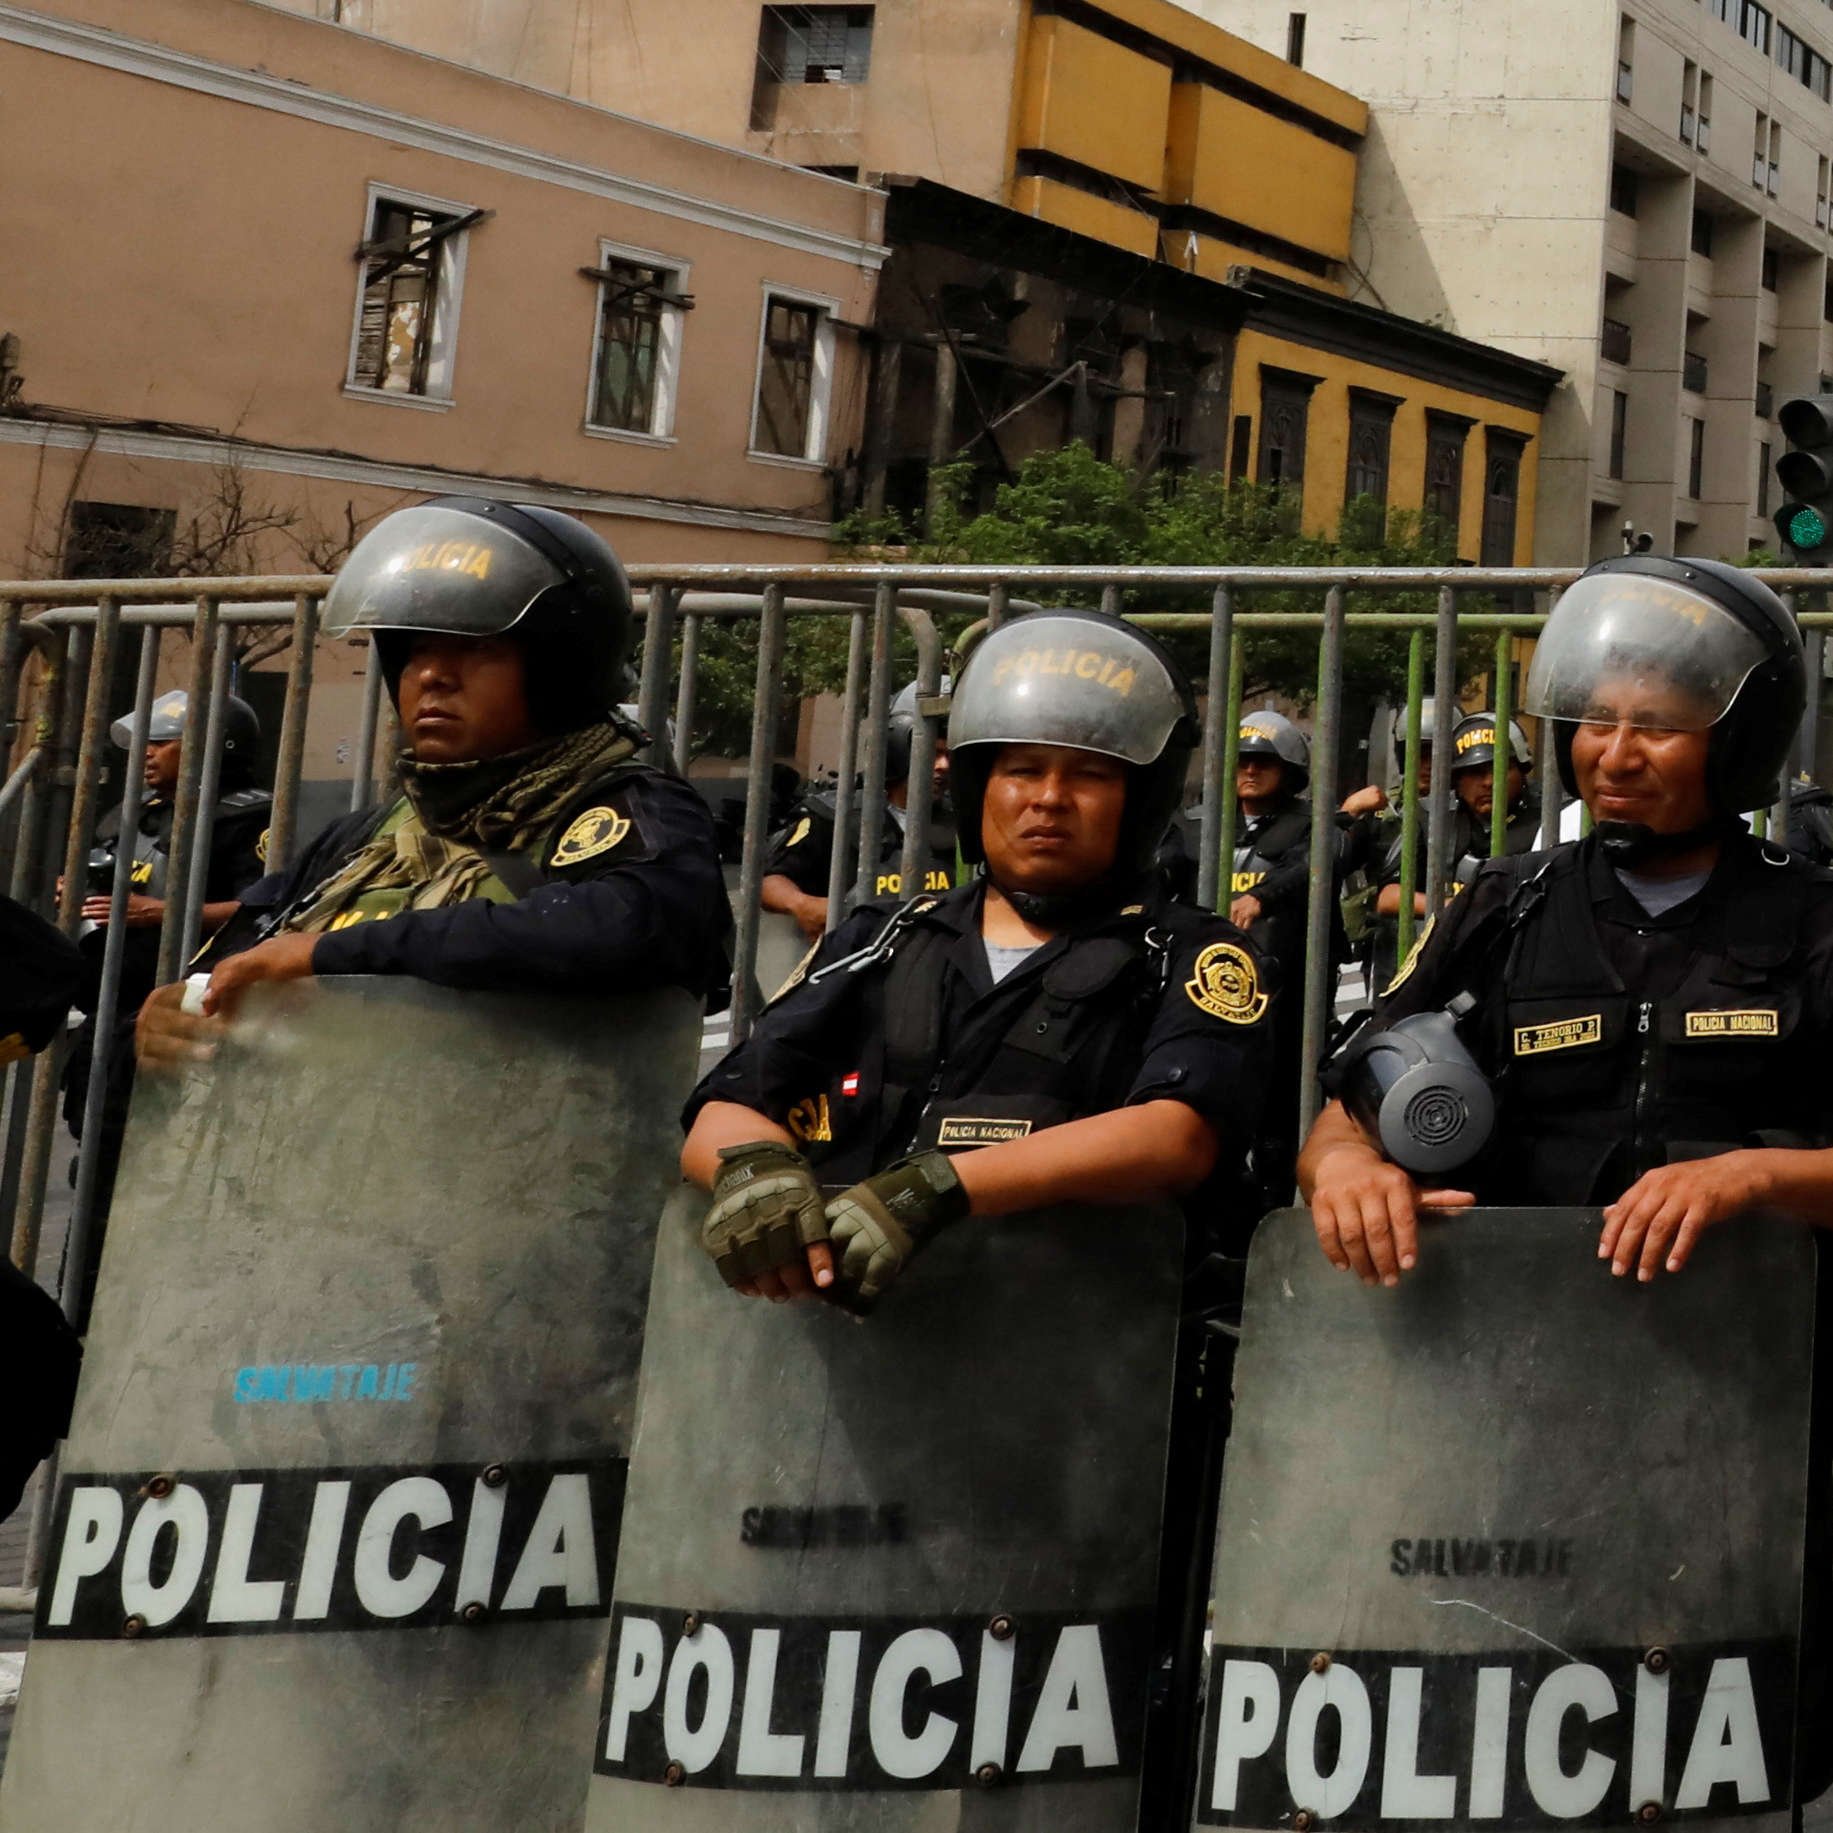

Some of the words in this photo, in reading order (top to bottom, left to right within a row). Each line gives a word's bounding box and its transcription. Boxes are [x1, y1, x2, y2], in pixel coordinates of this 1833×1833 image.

[386, 537, 493, 581] OLICIA
[991, 648, 1137, 697] POLICIA
[1455, 727, 1496, 755] POLICI
[876, 870, 950, 896] POCIA
[1536, 1024, 1580, 1041] TENORIO
[1693, 1016, 1725, 1031] POLICIA
[1731, 1016, 1773, 1031] NACIONAL
[944, 1124, 977, 1139] POLICIA
[979, 1126, 1027, 1140] NACIONAL
[47, 1473, 602, 1628] POLICIA
[605, 1615, 1120, 1780] POLICIA
[1210, 1656, 1771, 1820] POLICIA
